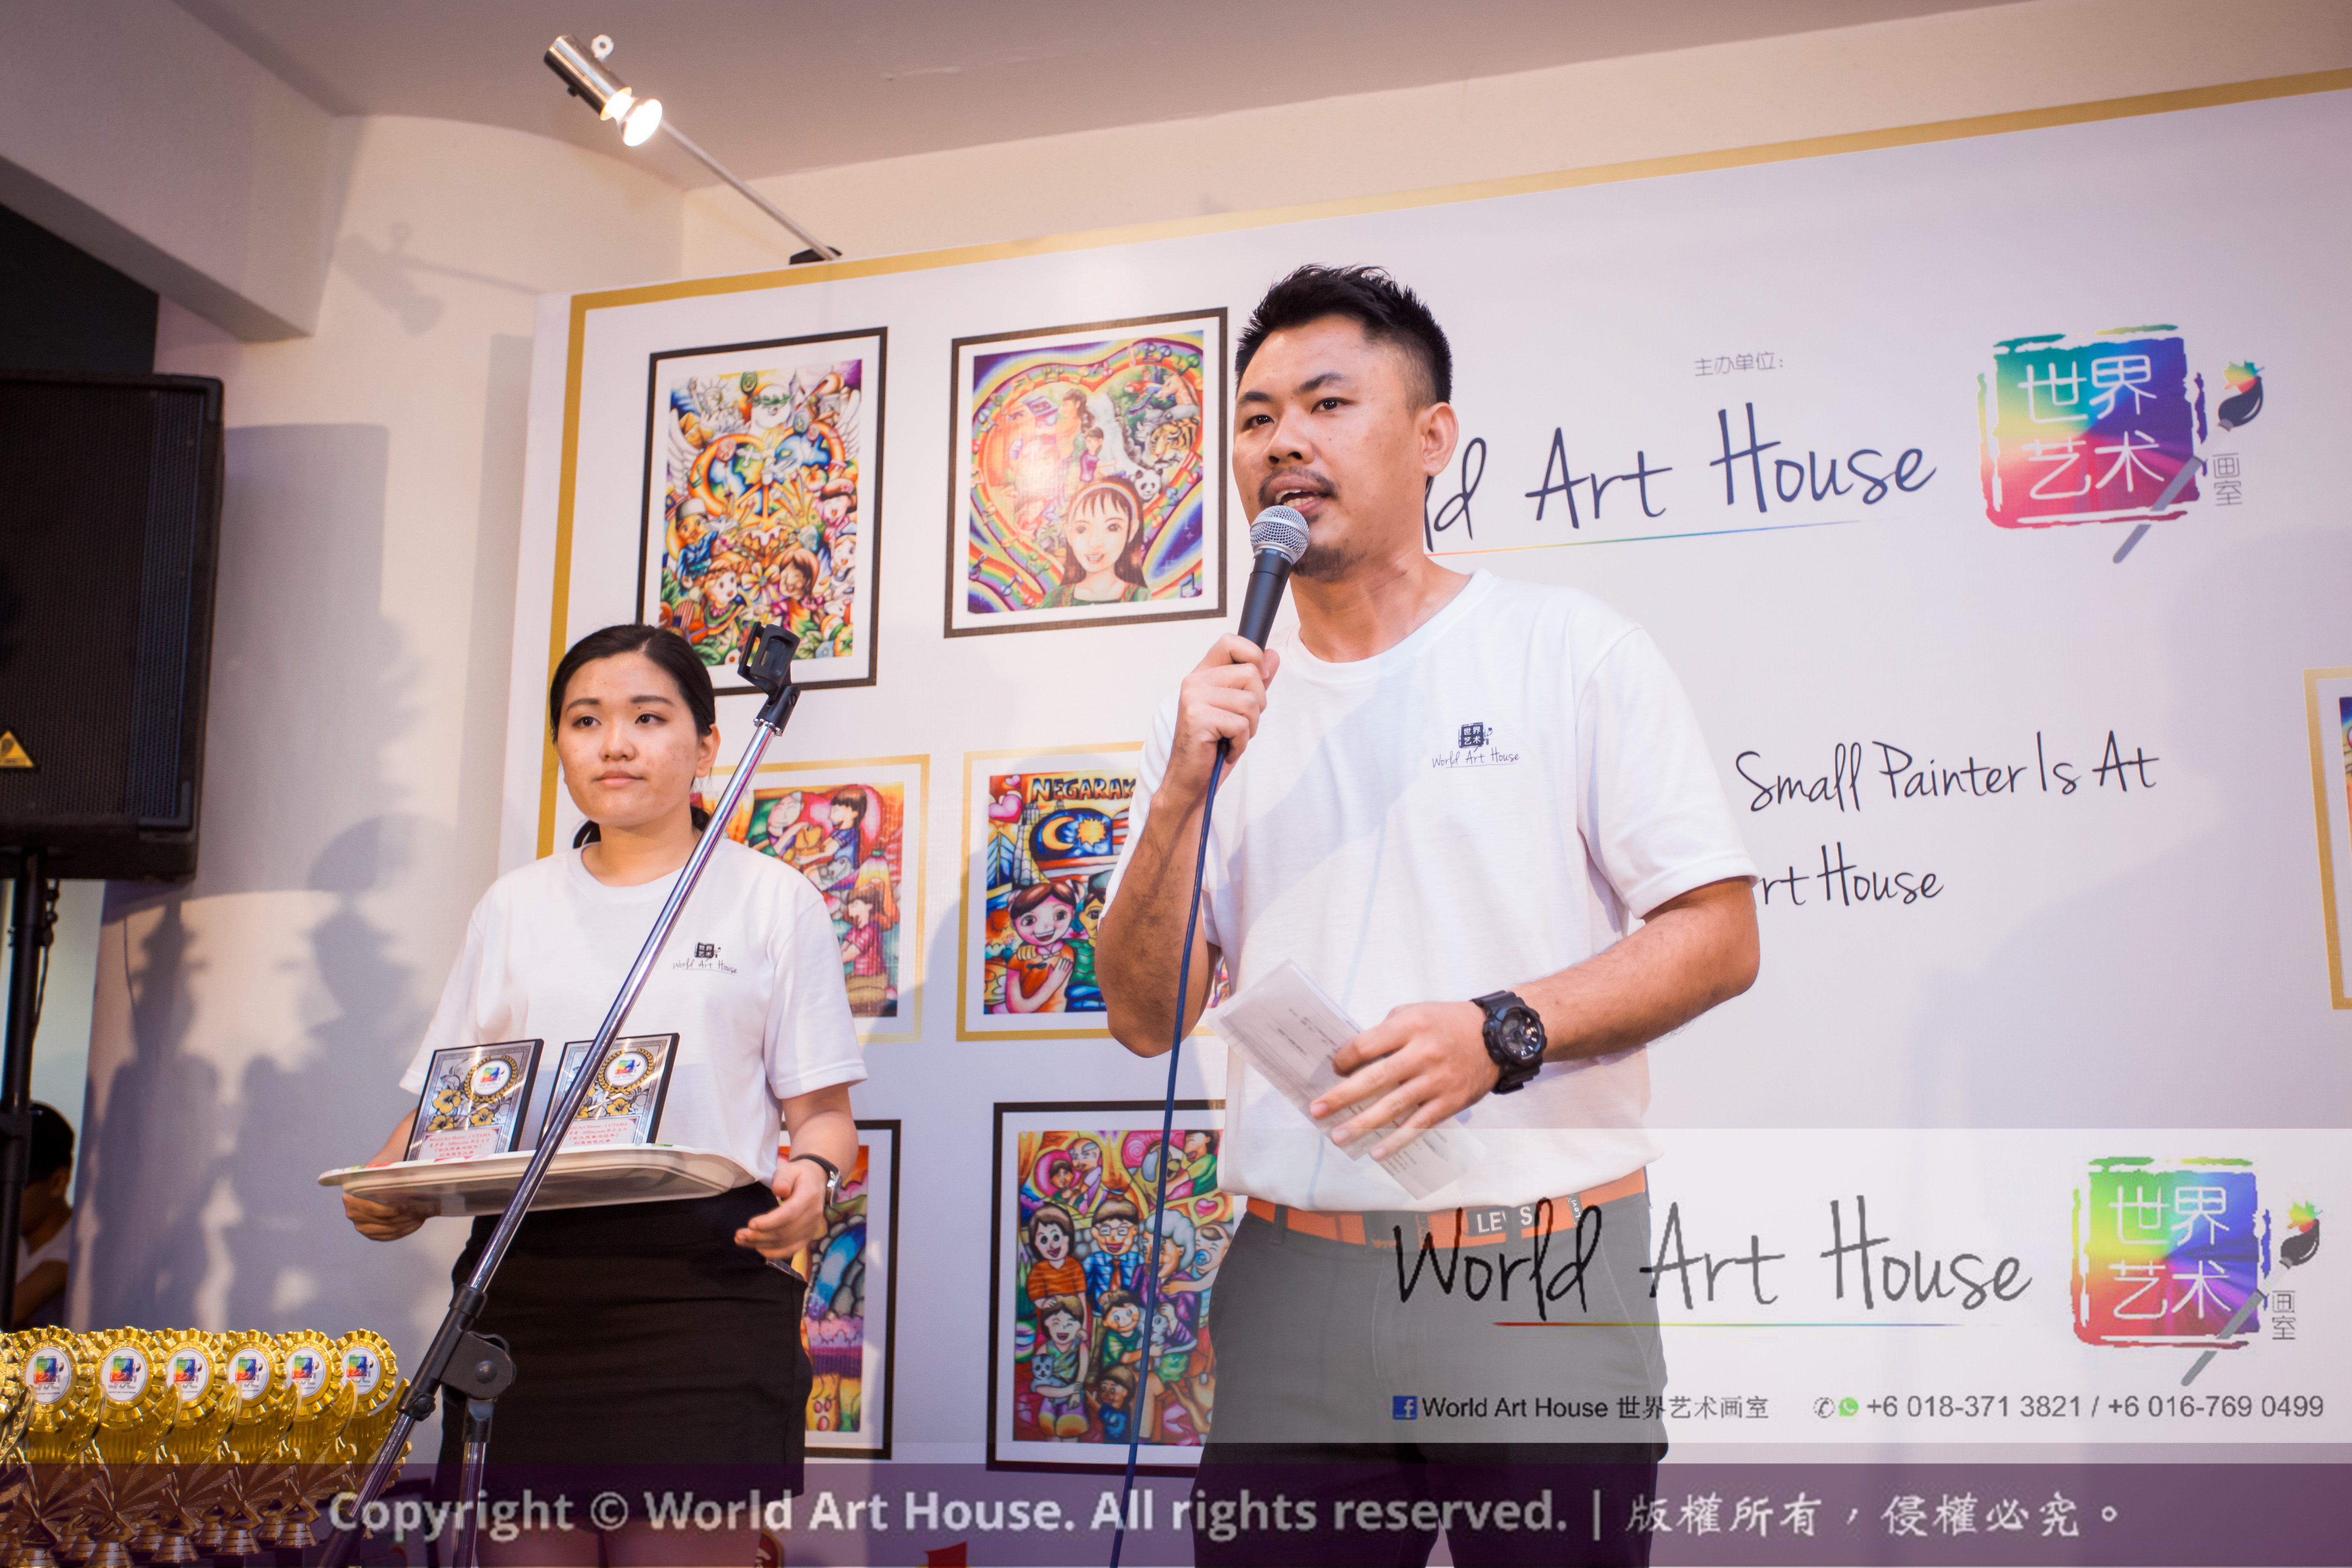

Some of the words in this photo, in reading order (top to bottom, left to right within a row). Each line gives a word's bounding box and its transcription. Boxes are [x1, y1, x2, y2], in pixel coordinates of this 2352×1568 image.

[2018, 355, 2157, 423] 世界
[1525, 427, 1672, 529] Art
[1710, 402, 1936, 513] House
[2021, 431, 2164, 499] 艺术
[2212, 453, 2242, 506] 画室
[1031, 778, 1136, 801] NEGARAK
[1432, 751, 1460, 768] World
[1465, 750, 1485, 764] Art
[1490, 747, 1520, 763] House
[1735, 742, 1861, 813] Small
[1872, 741, 2027, 799] Painter
[2037, 731, 2080, 795] Is
[2092, 730, 2159, 792] At
[1752, 866, 1810, 905] rt
[1816, 842, 1944, 906] House
[673, 958, 695, 970] World
[698, 959, 713, 968] Art
[717, 959, 738, 974] House
